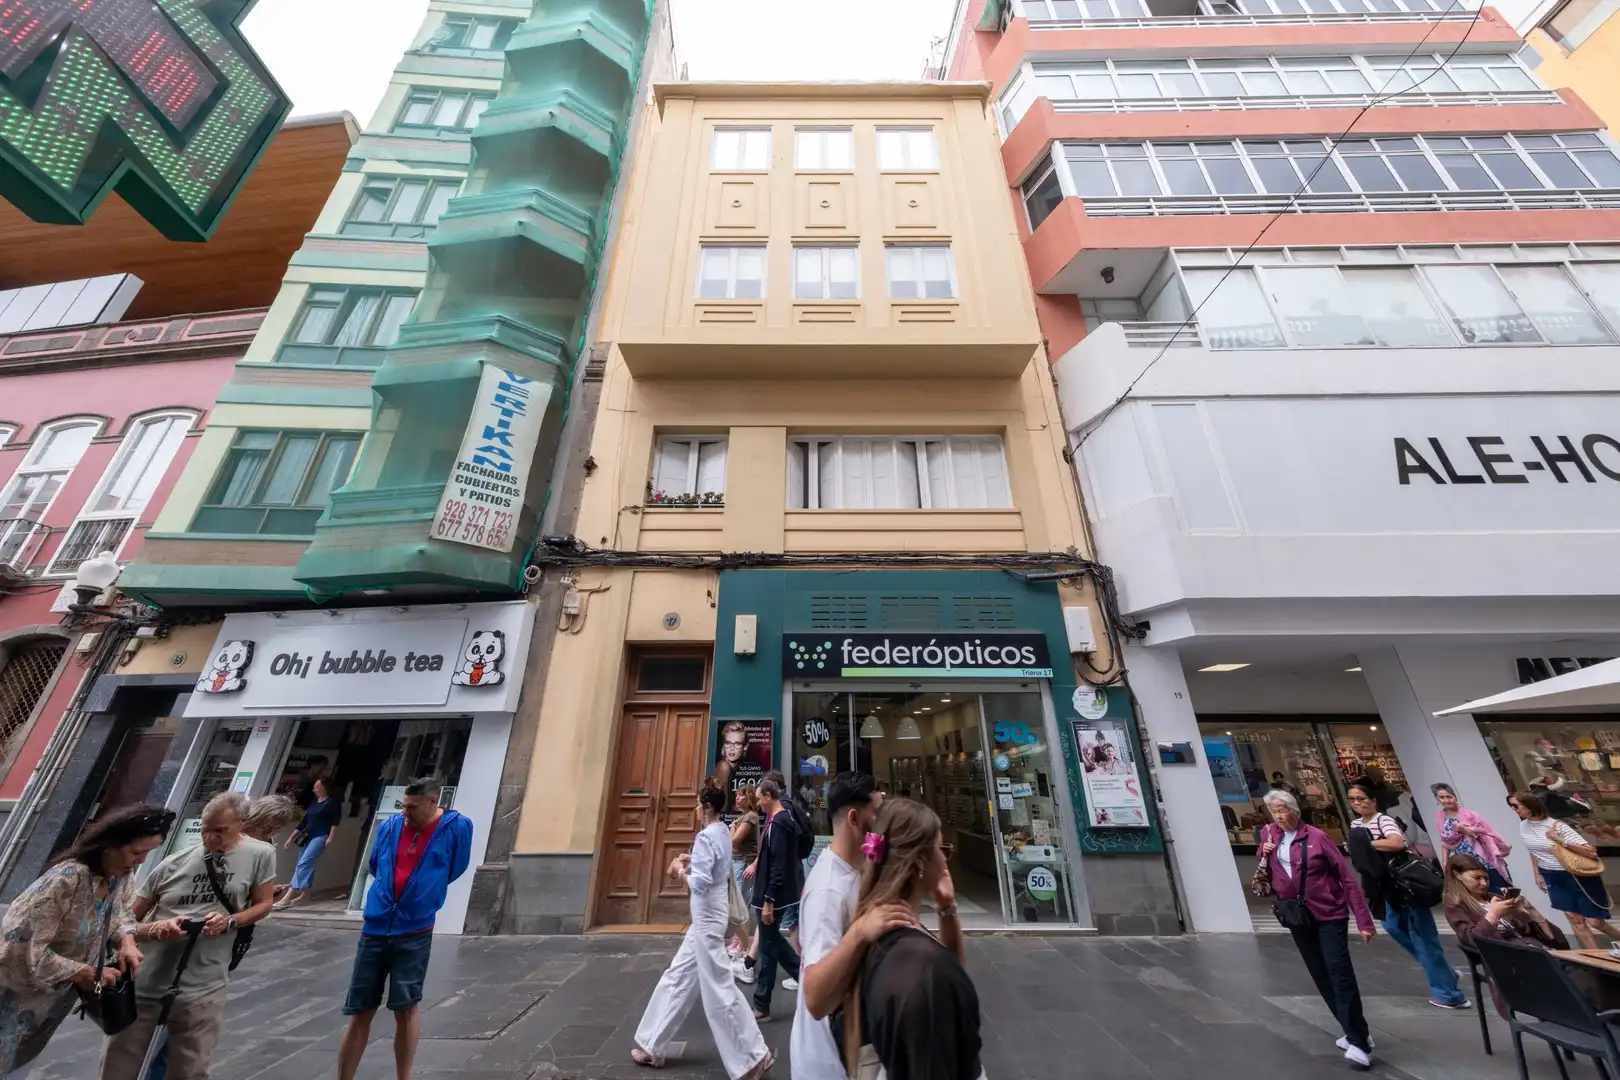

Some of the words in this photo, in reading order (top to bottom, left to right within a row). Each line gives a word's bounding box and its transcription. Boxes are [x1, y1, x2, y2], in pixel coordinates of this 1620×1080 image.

[456, 461, 519, 485] FACHADAS
[455, 474, 520, 498] CUBIERTAS
[459, 487, 468, 497] Y
[469, 490, 512, 508] PATIOS
[443, 499, 466, 520] 928
[467, 505, 490, 526] 371
[492, 510, 514, 531] 723
[437, 516, 463, 538] 677
[462, 522, 485, 544] 578
[318, 649, 396, 675] bubble
[403, 650, 444, 672] tea
[841, 638, 1037, 672] federópticos
[1174, 691, 1183, 700] 19
[178, 895, 197, 906] MY
